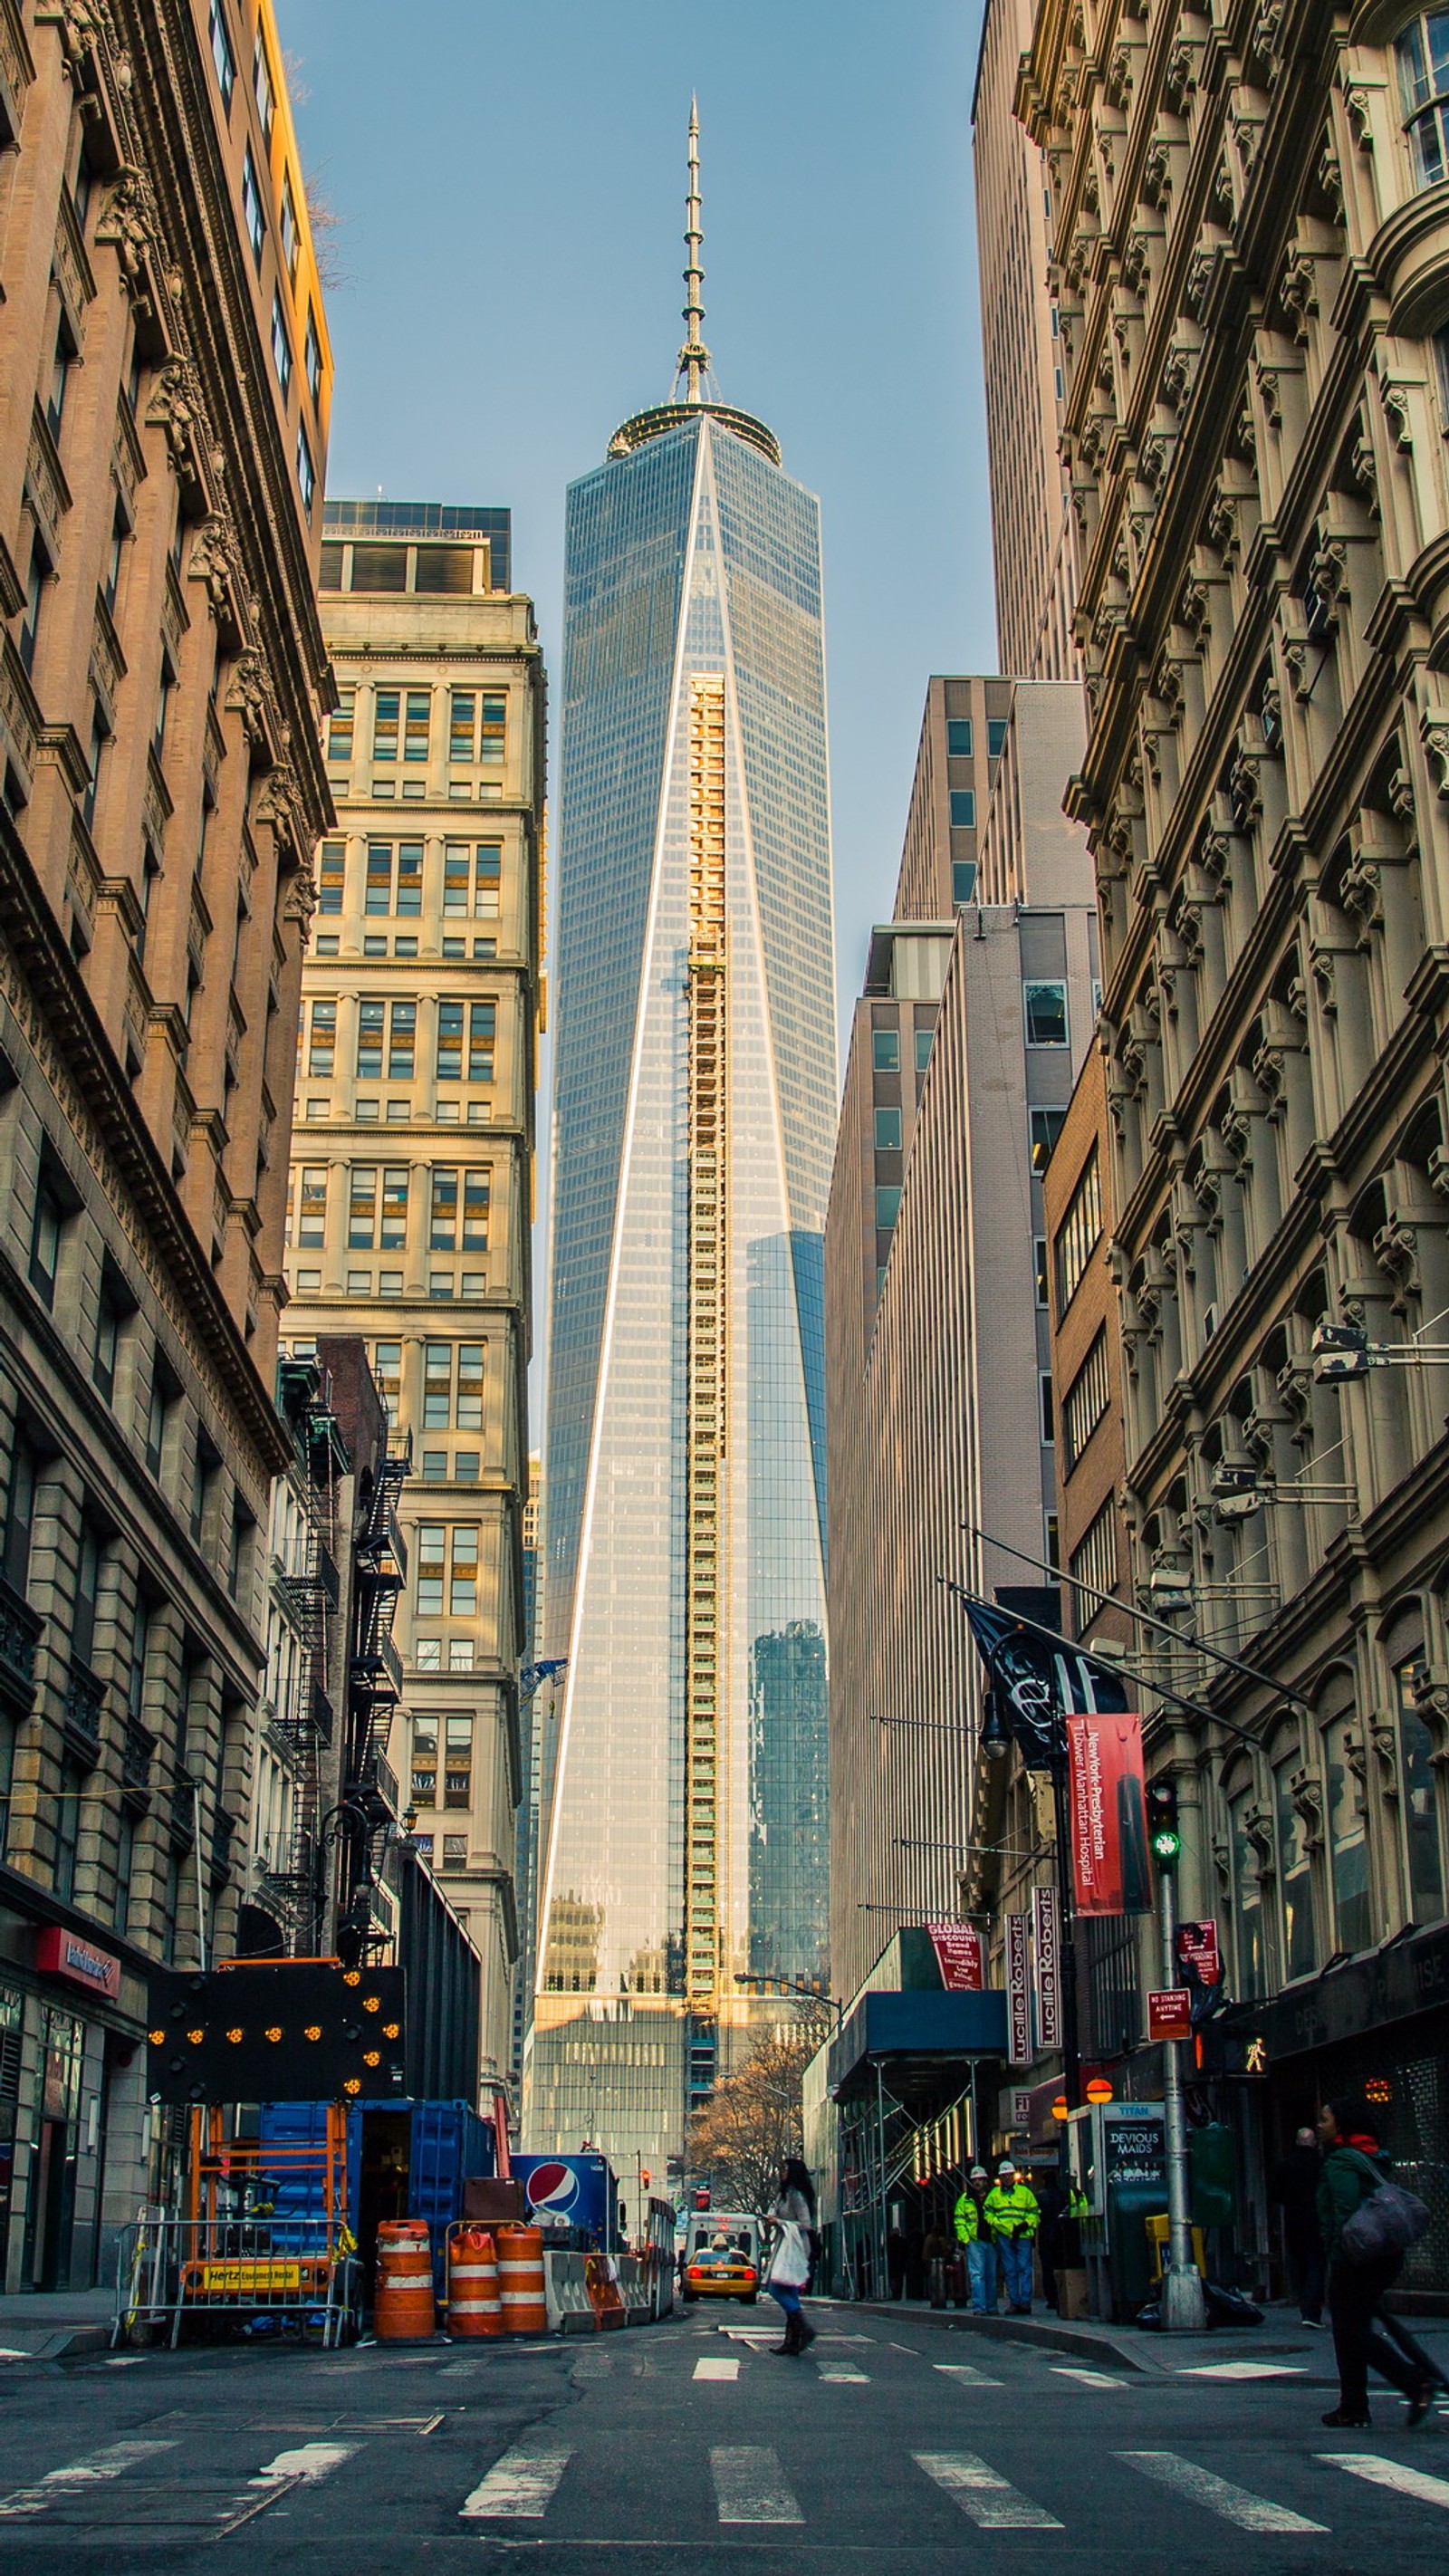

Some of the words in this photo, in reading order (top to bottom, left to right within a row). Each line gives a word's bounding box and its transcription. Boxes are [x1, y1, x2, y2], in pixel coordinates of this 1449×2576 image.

[1074, 1732, 1085, 1767] Lower
[1075, 1770, 1089, 1833] Manhattan
[1089, 1733, 1106, 1860] NewYork-Presbyterian
[1077, 1836, 1094, 1886] Hospital
[928, 1924, 975, 1935] GLOBAL
[1039, 1889, 1052, 1972] Roberts
[932, 1935, 976, 1943] DISCOUNT
[1011, 1916, 1024, 1994] Roberts
[1151, 1994, 1159, 2004] NO
[1161, 1994, 1186, 2003] STANDING
[1043, 1976, 1055, 2045] Lucille
[1156, 2004, 1182, 2013] ANYTIME
[1014, 1997, 1026, 2062] Lucille
[1015, 2097, 1030, 2110] FI
[1119, 2107, 1148, 2115] TITAN
[1110, 2133, 1159, 2144] DEVIOUS
[1118, 2144, 1153, 2155] MAIDS
[210, 2271, 240, 2281] Hertz
